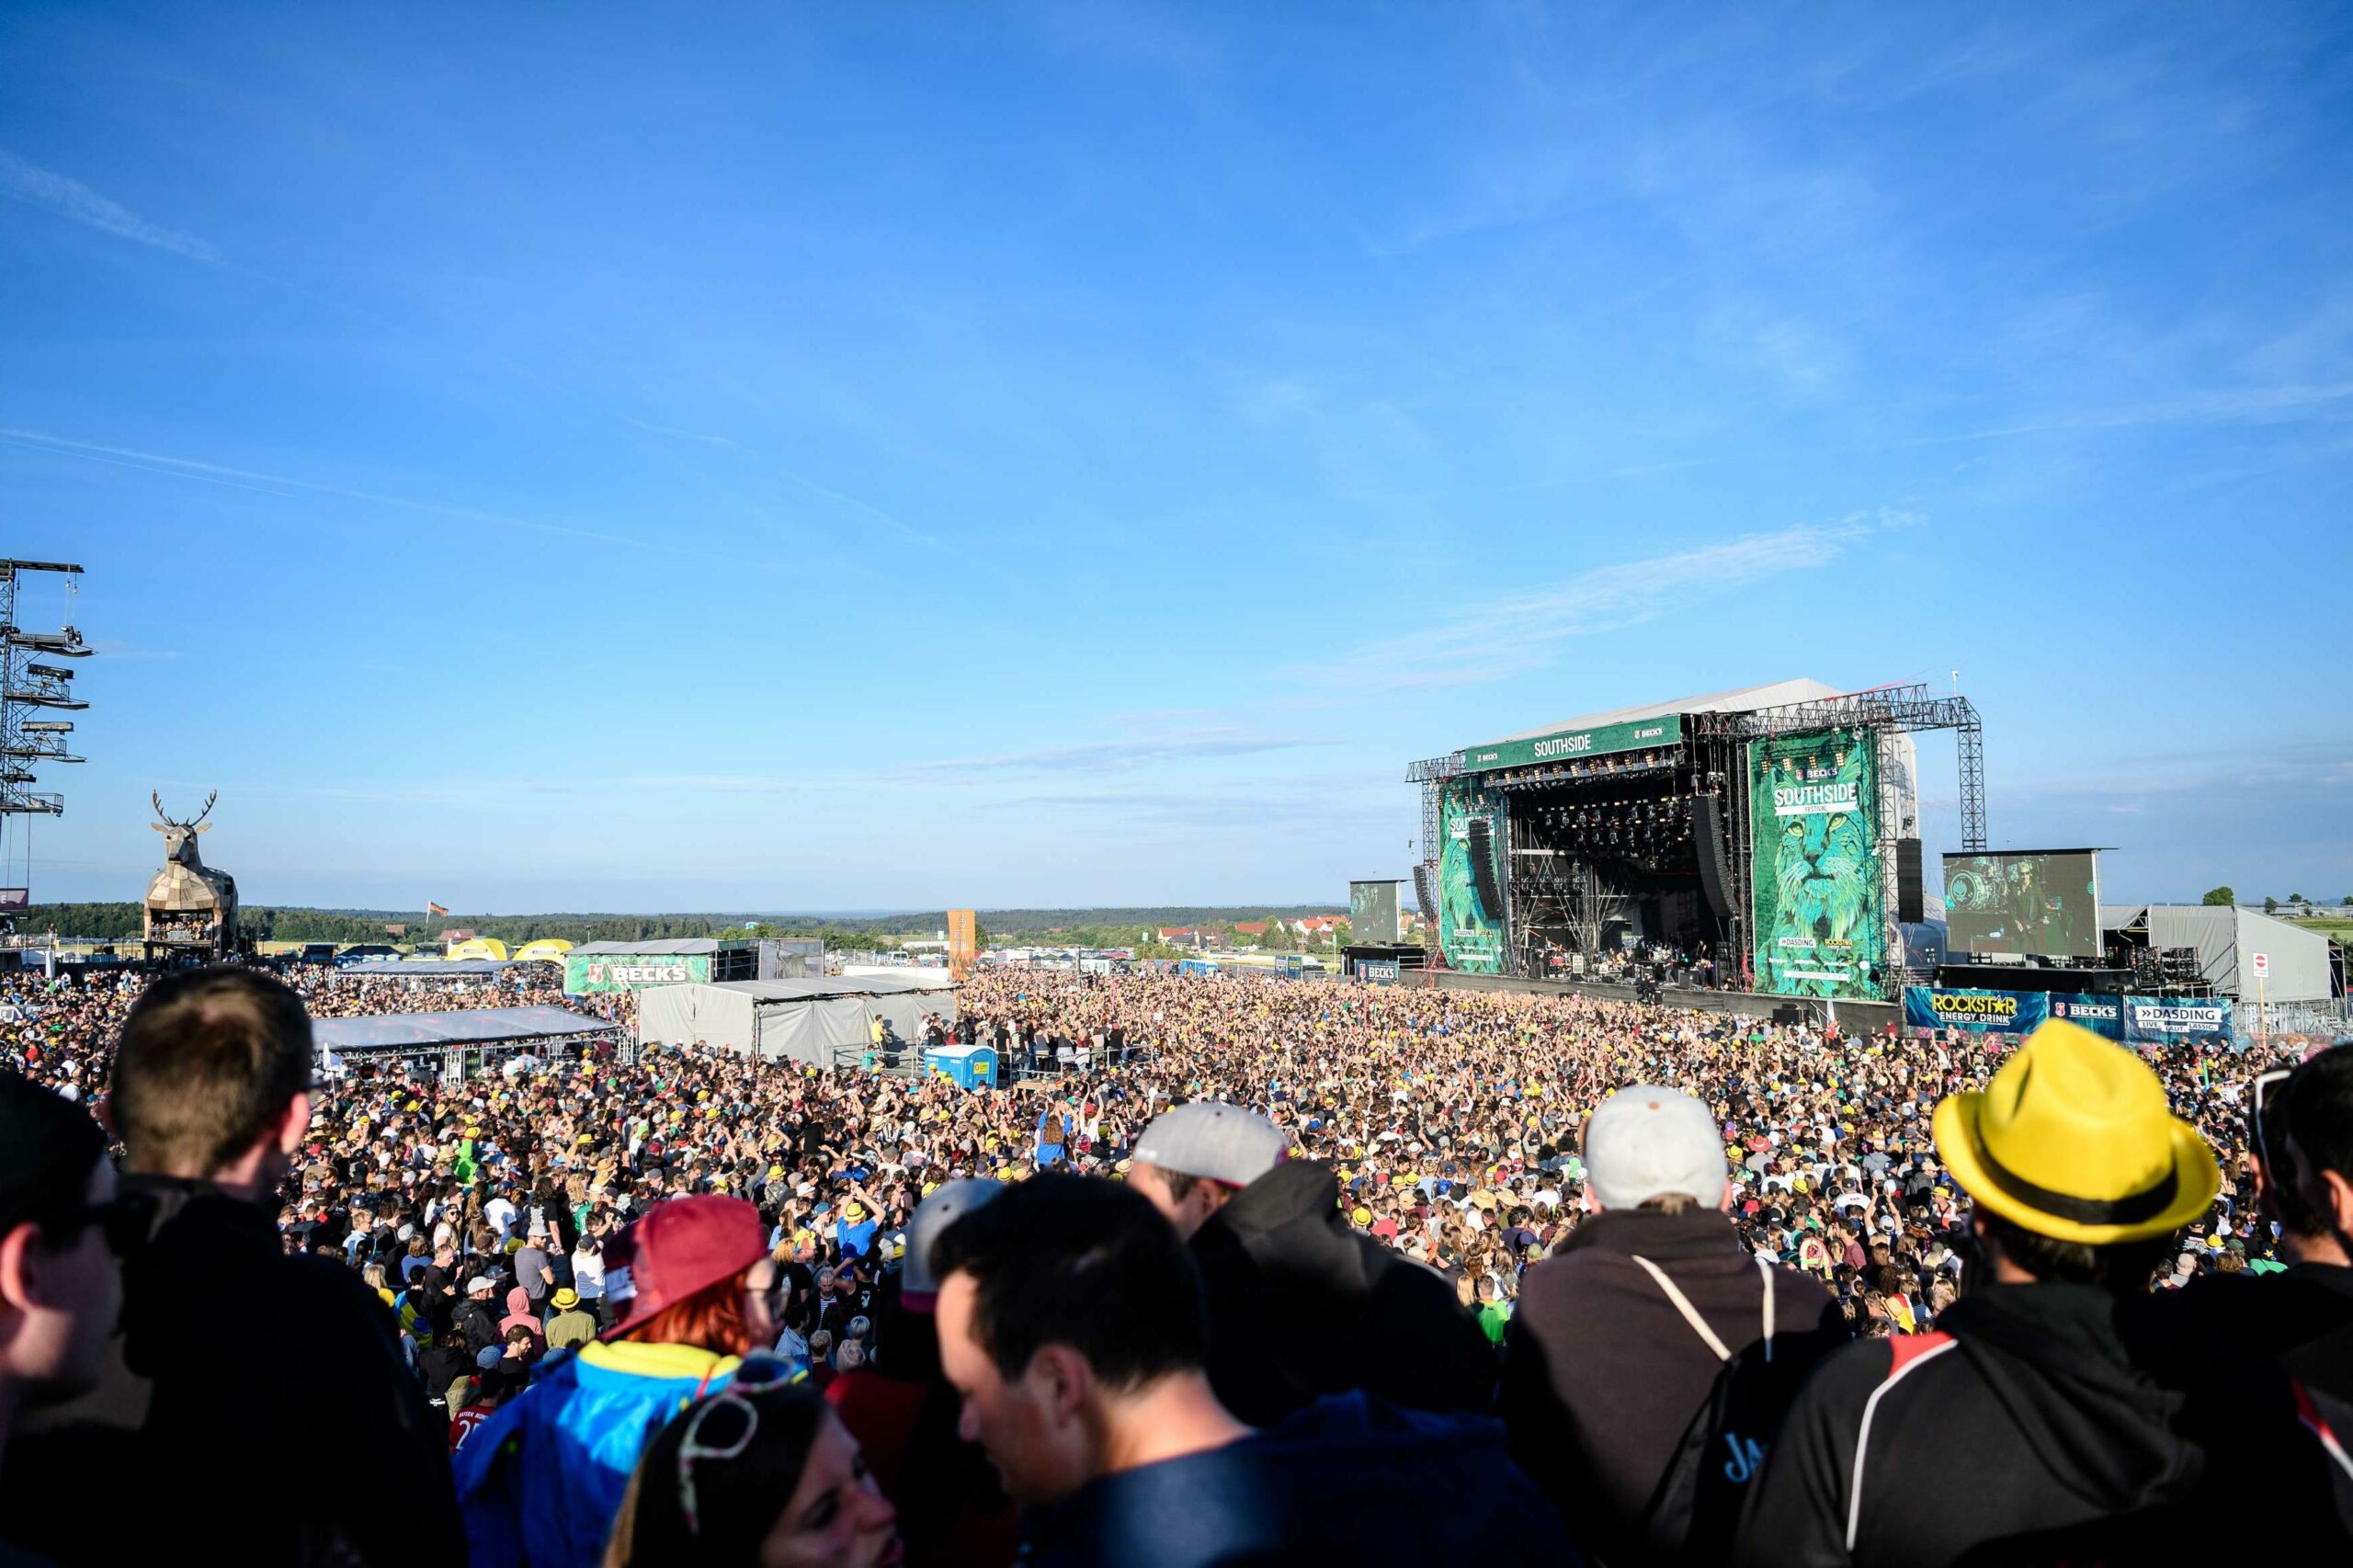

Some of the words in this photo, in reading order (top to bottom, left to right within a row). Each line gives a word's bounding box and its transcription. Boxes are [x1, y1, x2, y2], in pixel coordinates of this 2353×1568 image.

[1534, 734, 1591, 757] SOUTHSIDE
[1774, 783, 1857, 806] SOUTHSIDE
[1786, 937, 1813, 947] DASDING
[613, 965, 687, 982] BECK'S
[1369, 966, 1394, 979] BECK'S
[1939, 1011, 1975, 1022] ENERGY
[1979, 1013, 2010, 1025] DRINK
[2070, 1005, 2118, 1018] BECK'S
[2153, 1008, 2215, 1020] DASDING
